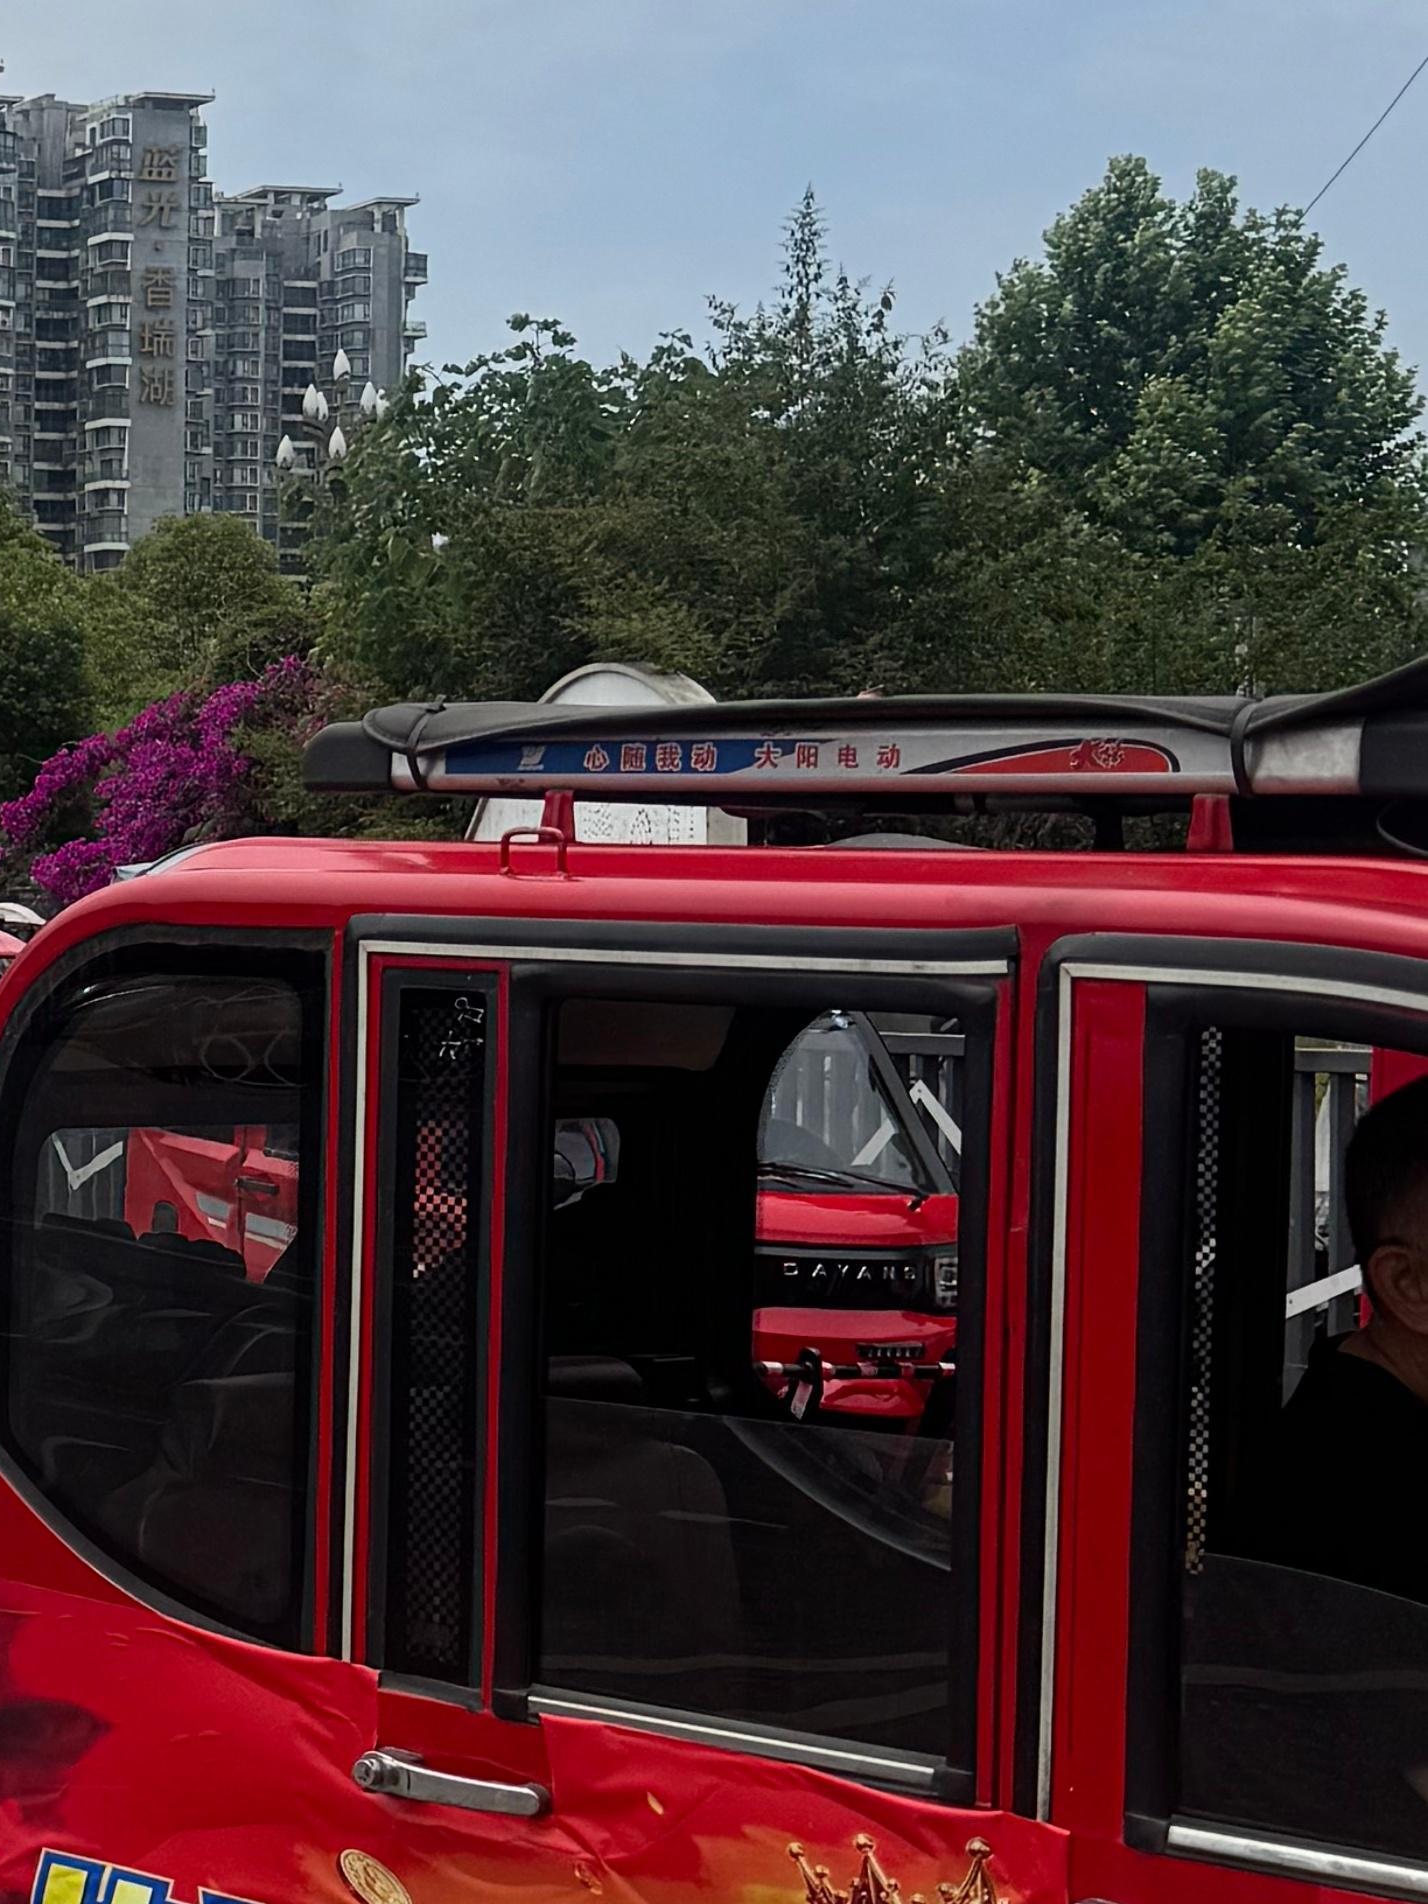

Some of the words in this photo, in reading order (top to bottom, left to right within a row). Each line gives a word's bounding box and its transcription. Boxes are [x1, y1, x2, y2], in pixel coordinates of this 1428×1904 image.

[583, 743, 718, 772] 心随我动
[753, 744, 902, 772] 大阳电动
